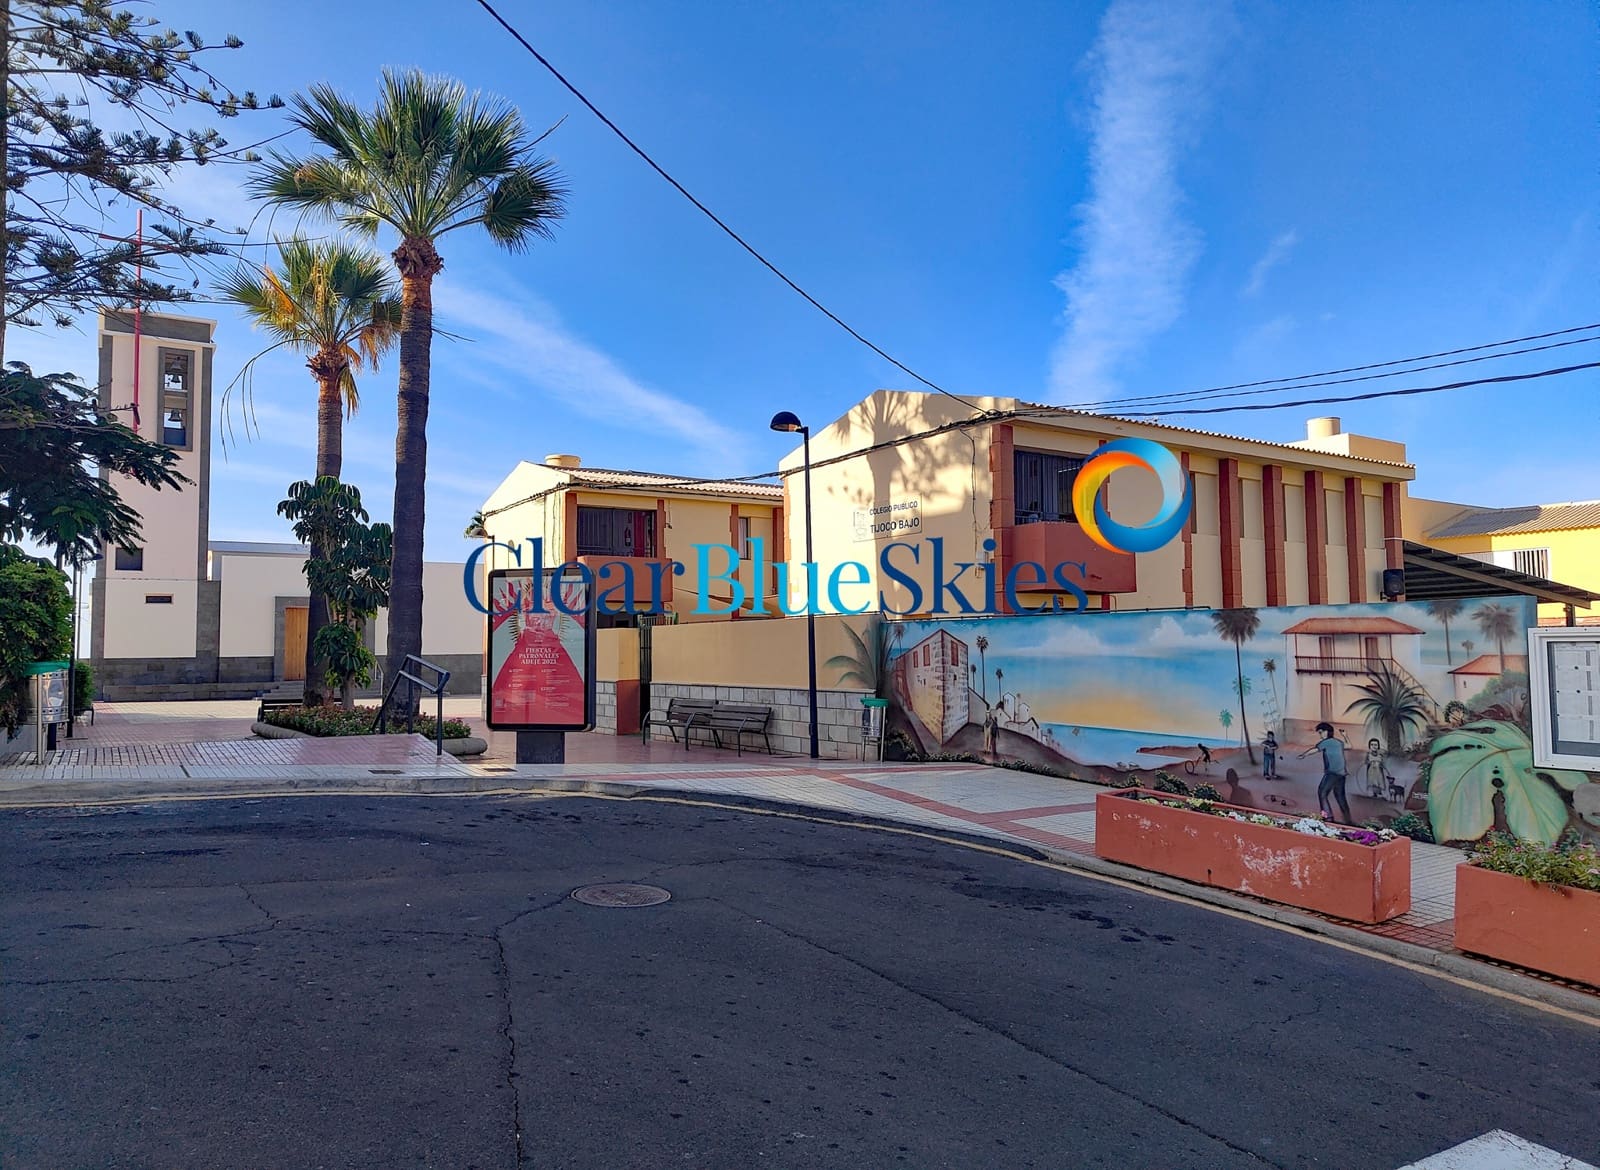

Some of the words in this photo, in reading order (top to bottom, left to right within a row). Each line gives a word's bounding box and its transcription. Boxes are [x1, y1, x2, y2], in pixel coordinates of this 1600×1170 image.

[869, 505, 893, 515] COLEGIO
[893, 501, 918, 511] PUBLICO
[870, 521, 897, 533] TIJOCO
[898, 517, 920, 529] BAJO
